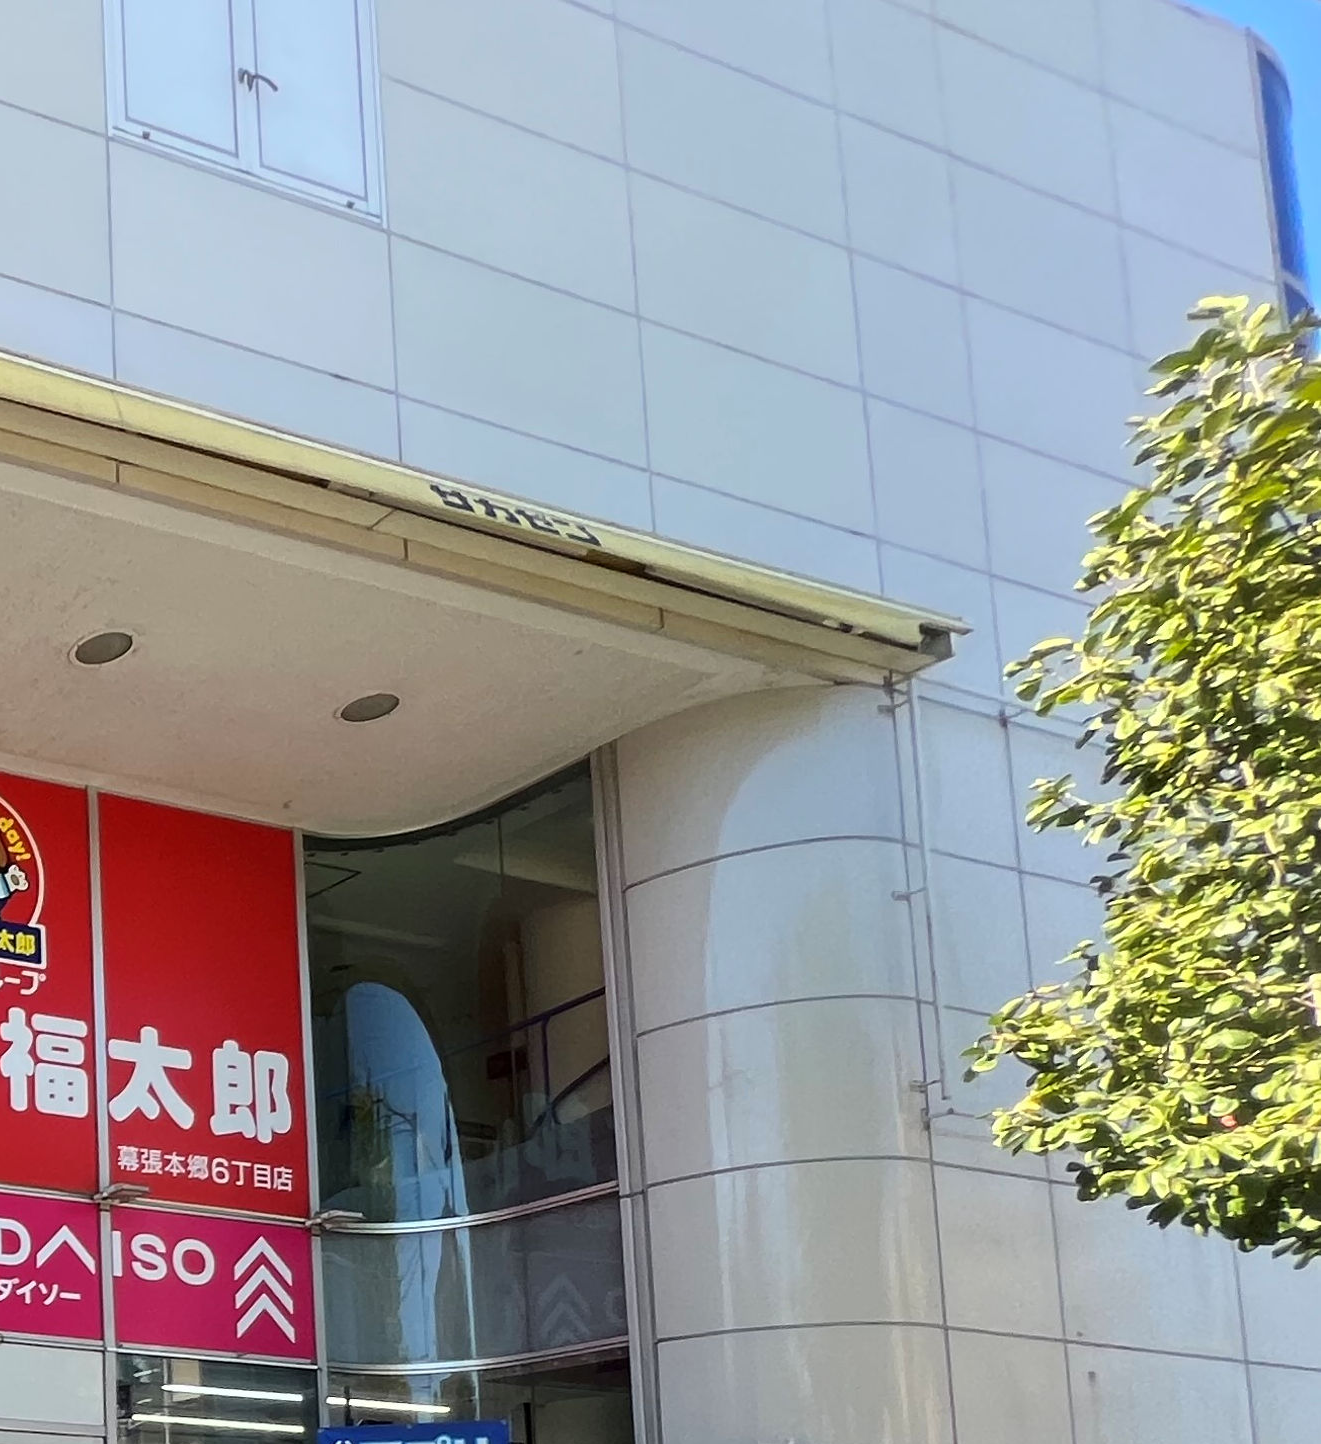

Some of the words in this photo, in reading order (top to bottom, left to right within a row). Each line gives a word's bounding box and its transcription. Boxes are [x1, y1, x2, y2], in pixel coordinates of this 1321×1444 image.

[429, 482, 603, 547] サカゼン
[116, 1143, 294, 1193] 幕張本郷6丁目店
